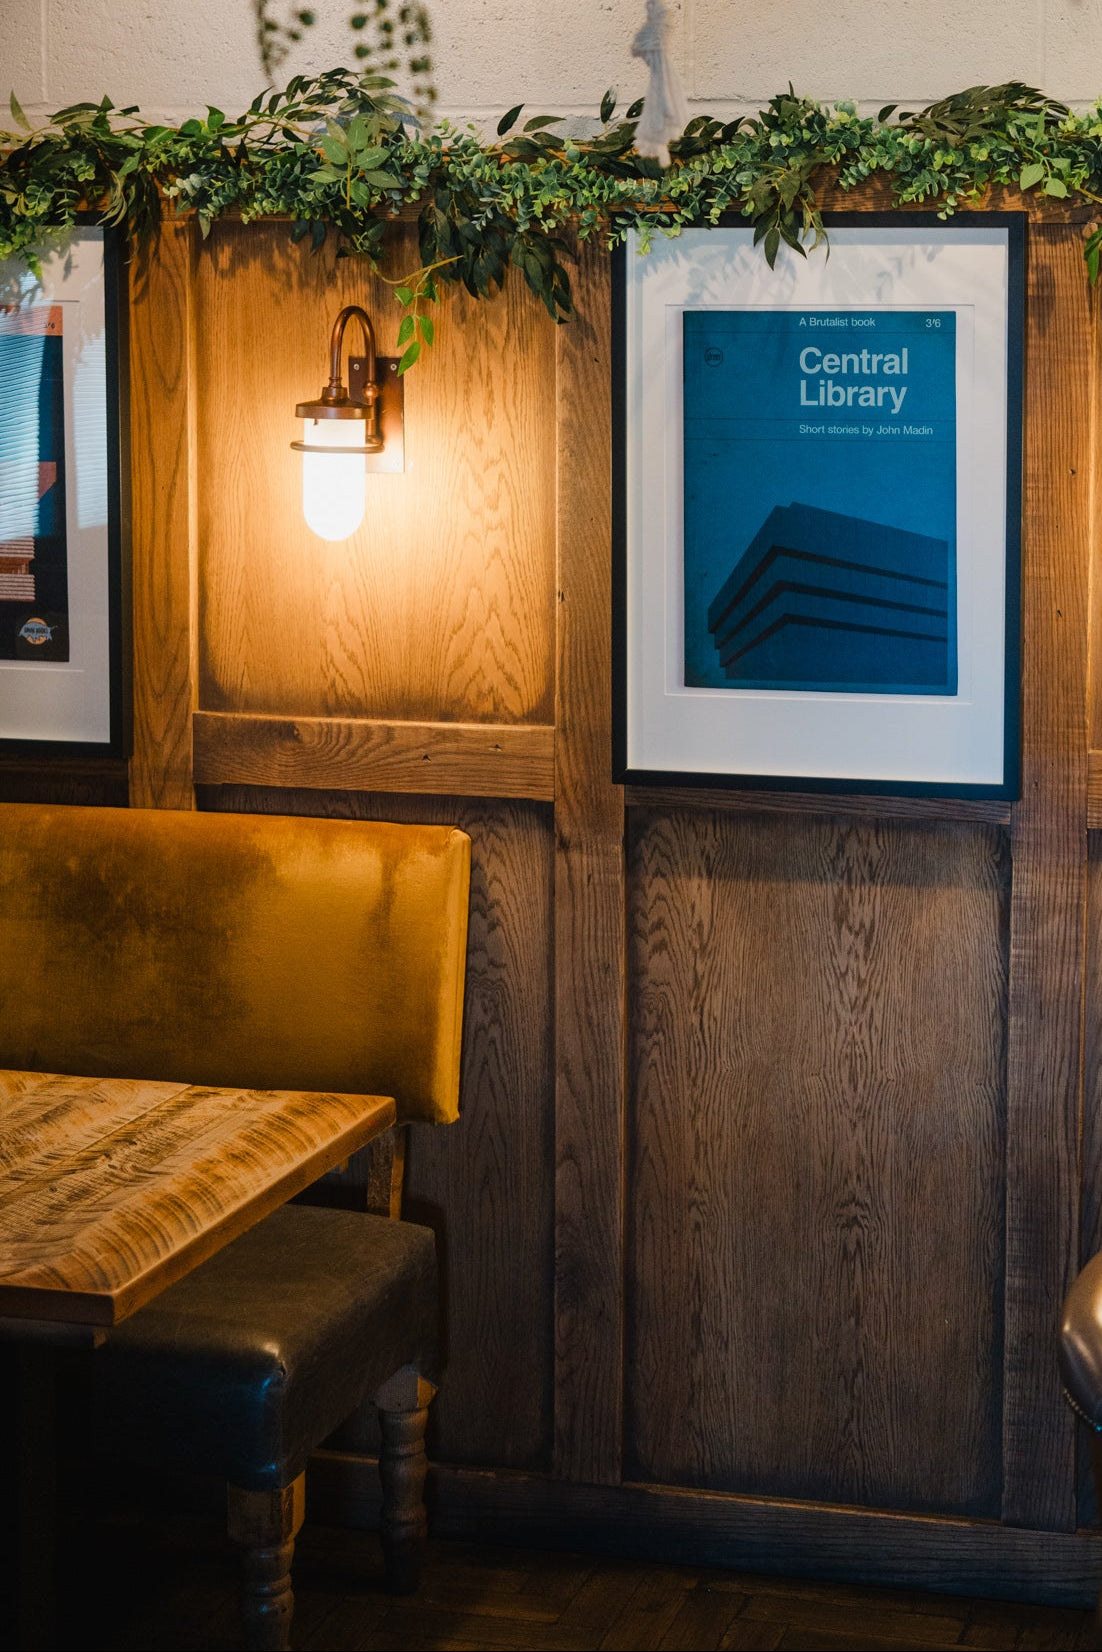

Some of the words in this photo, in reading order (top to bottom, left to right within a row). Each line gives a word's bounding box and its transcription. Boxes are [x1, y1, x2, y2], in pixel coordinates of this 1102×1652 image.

[799, 318, 807, 327] A
[809, 317, 849, 327] Brutalist
[851, 317, 876, 327] book
[799, 346, 909, 375] Central
[800, 379, 908, 415] Library
[799, 424, 825, 434] Short
[827, 424, 860, 435] stories
[862, 424, 874, 436] by
[876, 425, 901, 435] John
[903, 425, 934, 436] Madin
